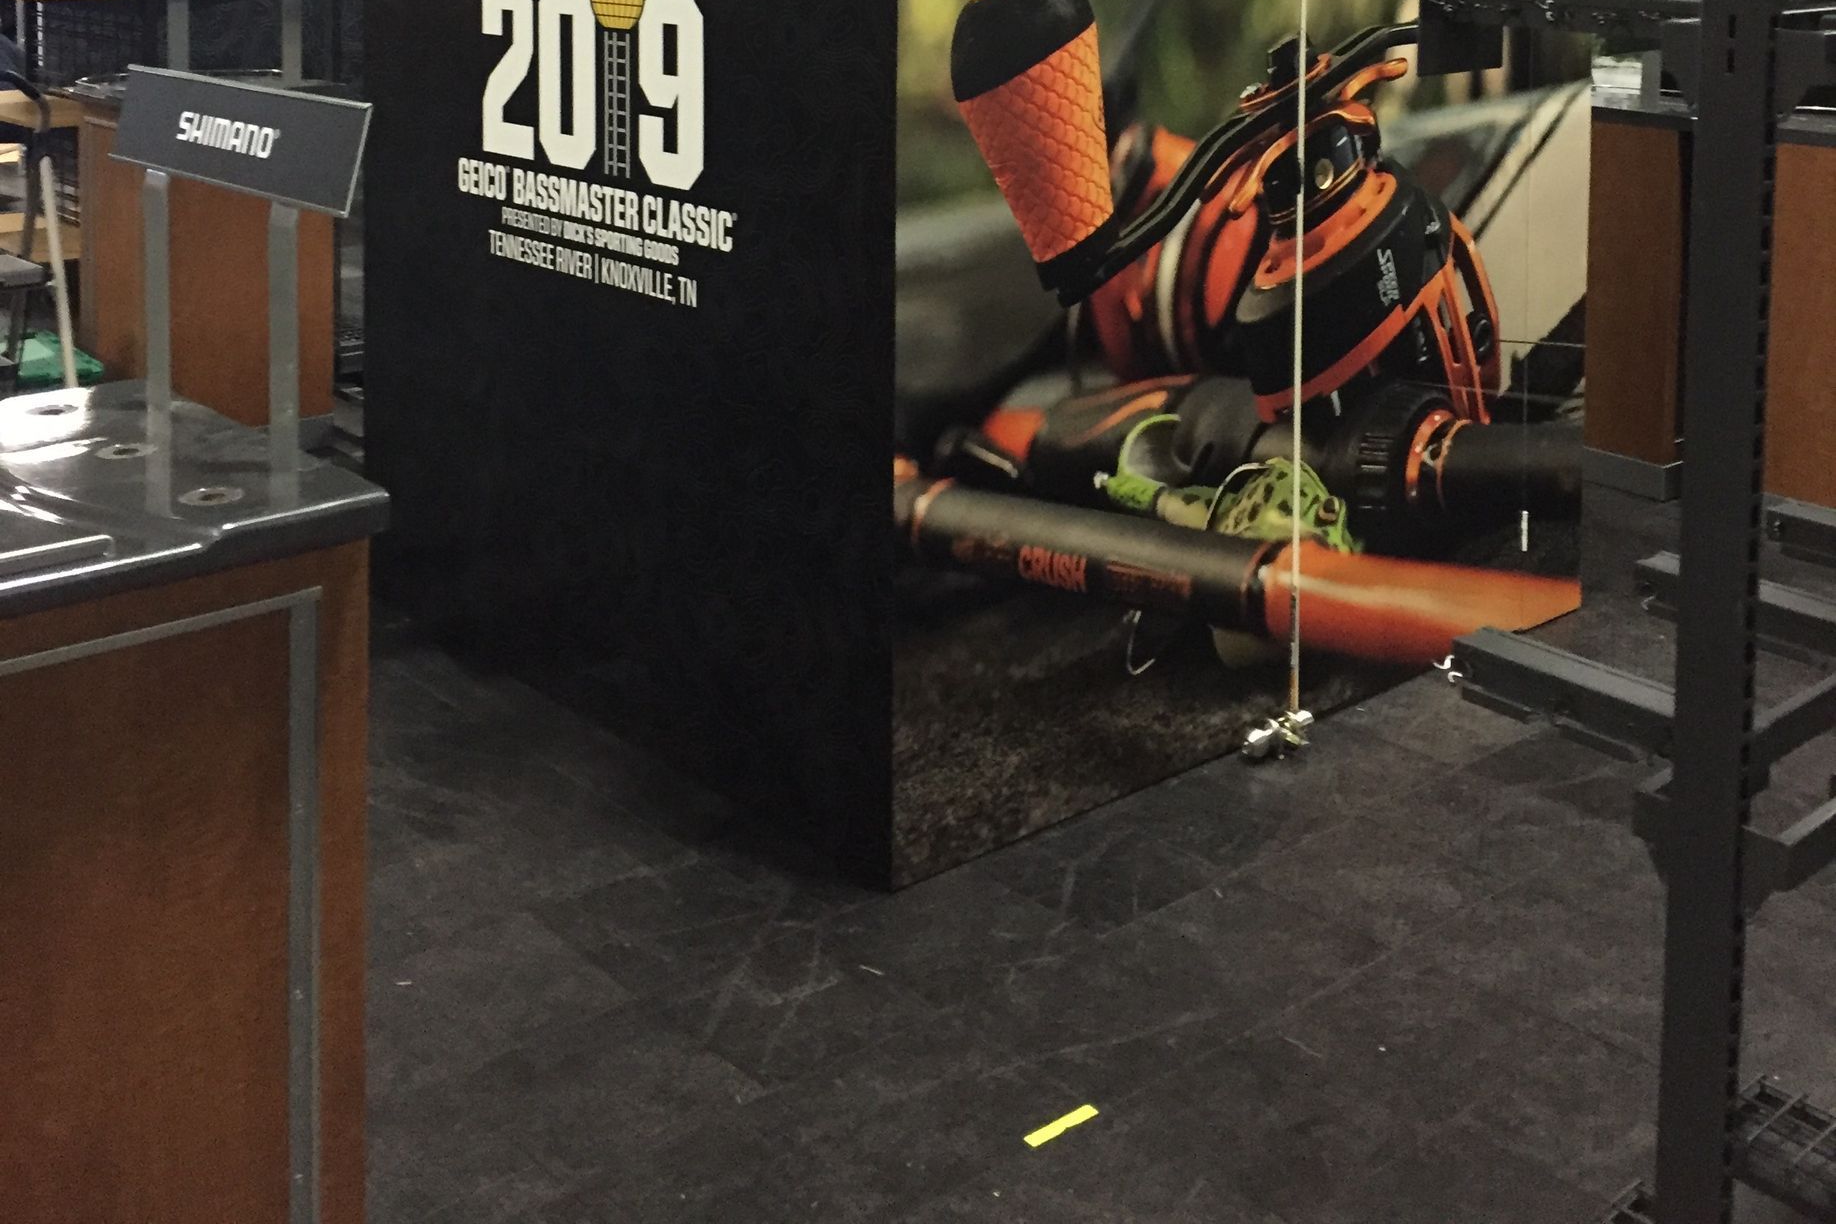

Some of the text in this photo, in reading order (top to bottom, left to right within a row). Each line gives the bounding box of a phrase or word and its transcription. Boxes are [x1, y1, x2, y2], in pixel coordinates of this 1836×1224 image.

[176, 111, 275, 159] SHIMANO
[458, 157, 733, 253] GEICO BASSMASTER CLASSIC
[502, 206, 551, 235] PRESENTED
[594, 227, 643, 257] SPORTING
[644, 238, 680, 266] GOODS
[488, 229, 555, 270] TENNESSEE
[555, 245, 593, 280] RIVER
[601, 257, 676, 306] KNOXVILLE,
[677, 276, 698, 308] TN
[1018, 544, 1088, 593] CRUSH
